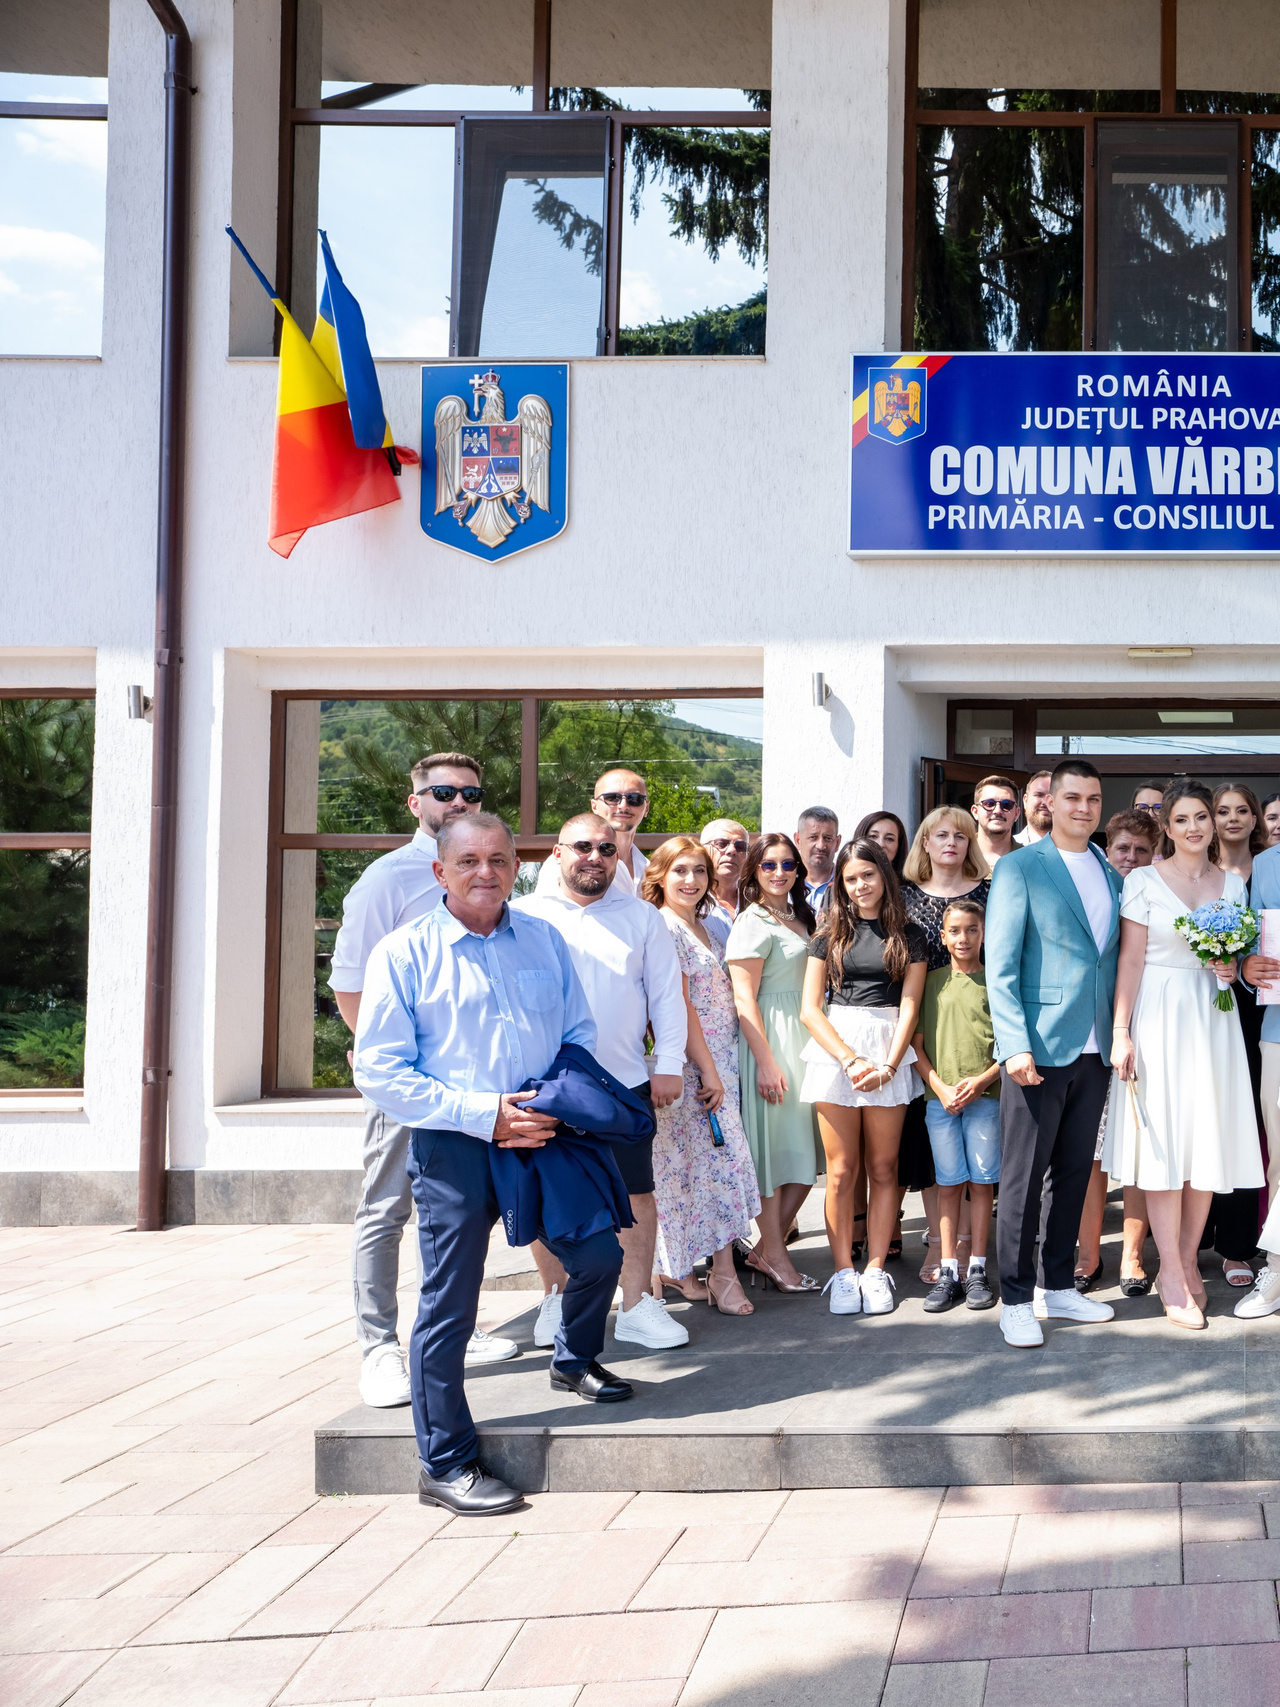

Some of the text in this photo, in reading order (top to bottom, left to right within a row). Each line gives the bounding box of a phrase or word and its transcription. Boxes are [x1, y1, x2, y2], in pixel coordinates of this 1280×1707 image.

[1077, 369, 1232, 397] ROMÂNIA
[1021, 407, 1143, 435] JUDEȚUL
[930, 446, 1136, 496] COMUNA
[928, 498, 1084, 529] PRIMĂRIA
[1113, 504, 1274, 529] CONSILIUL
